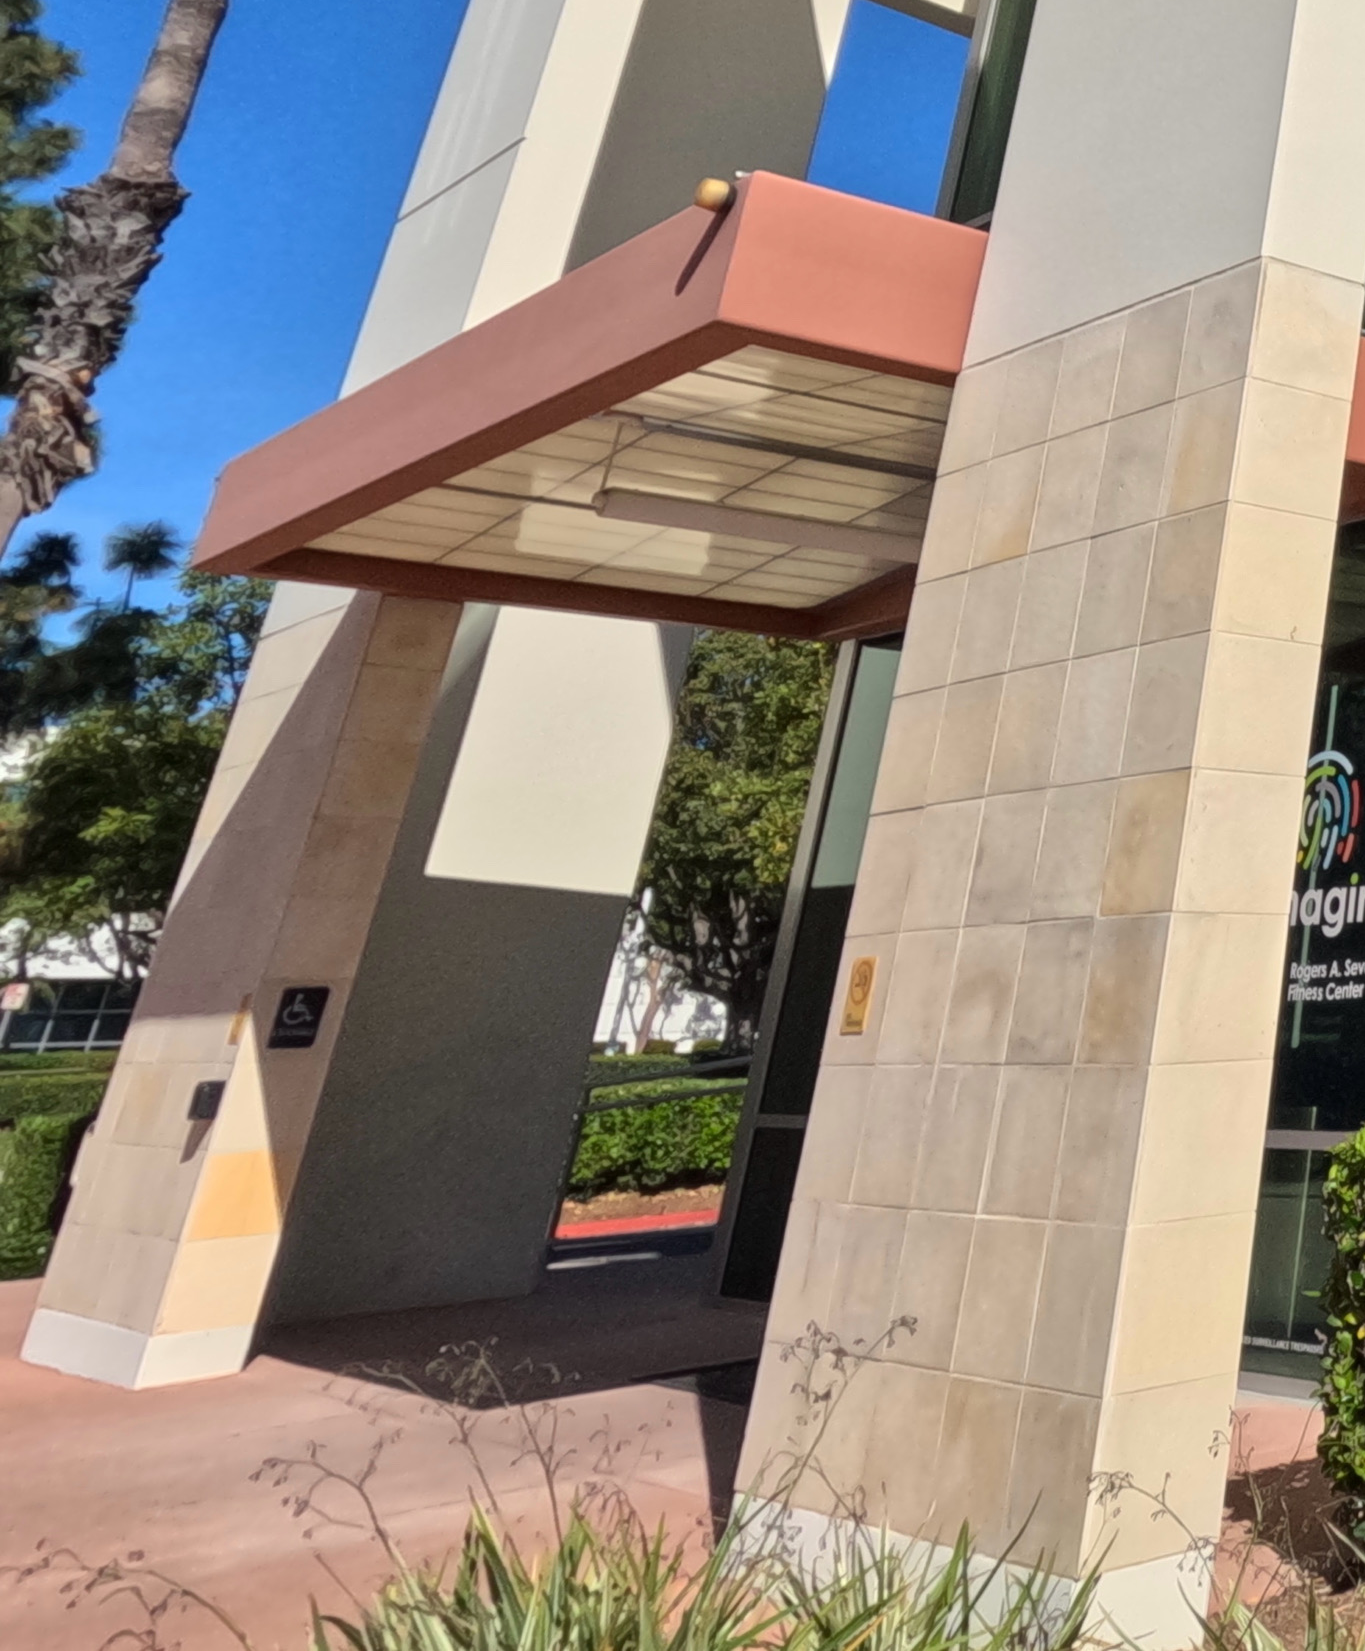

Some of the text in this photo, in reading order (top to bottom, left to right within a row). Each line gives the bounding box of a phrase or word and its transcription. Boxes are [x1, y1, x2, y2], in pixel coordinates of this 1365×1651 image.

[1289, 961, 1327, 983] Rogers
[1329, 959, 1342, 978] A.
[1287, 981, 1365, 1001] Fitness Center
